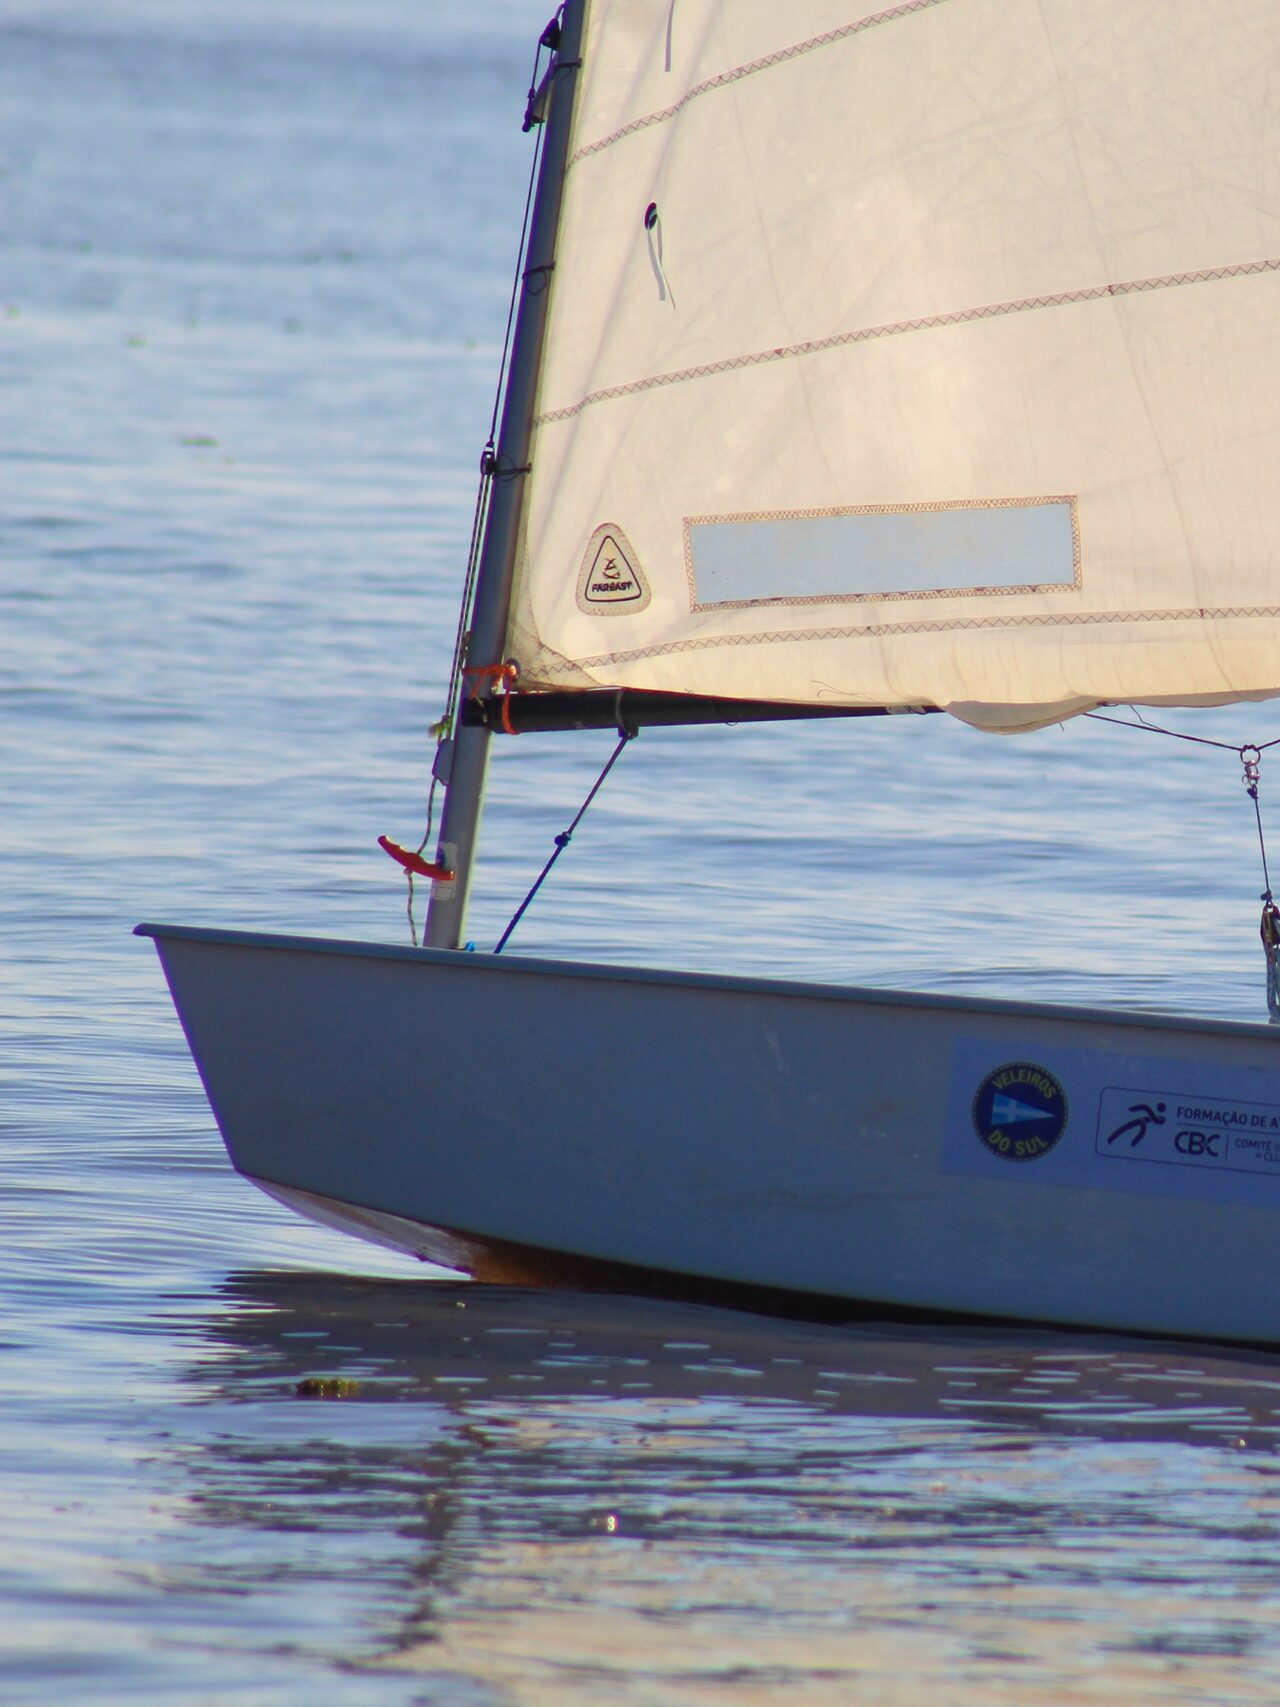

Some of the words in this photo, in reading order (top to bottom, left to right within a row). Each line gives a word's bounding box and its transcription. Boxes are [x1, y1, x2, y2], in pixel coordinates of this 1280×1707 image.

[592, 581, 633, 592] FAREAST
[992, 1069, 1056, 1098] VELEIROS
[1177, 1106, 1247, 1126] FORMAÇÃO
[1251, 1115, 1267, 1127] DE
[988, 1130, 1010, 1152] DO
[1016, 1136, 1048, 1155] SUL
[1174, 1130, 1220, 1158] CBC
